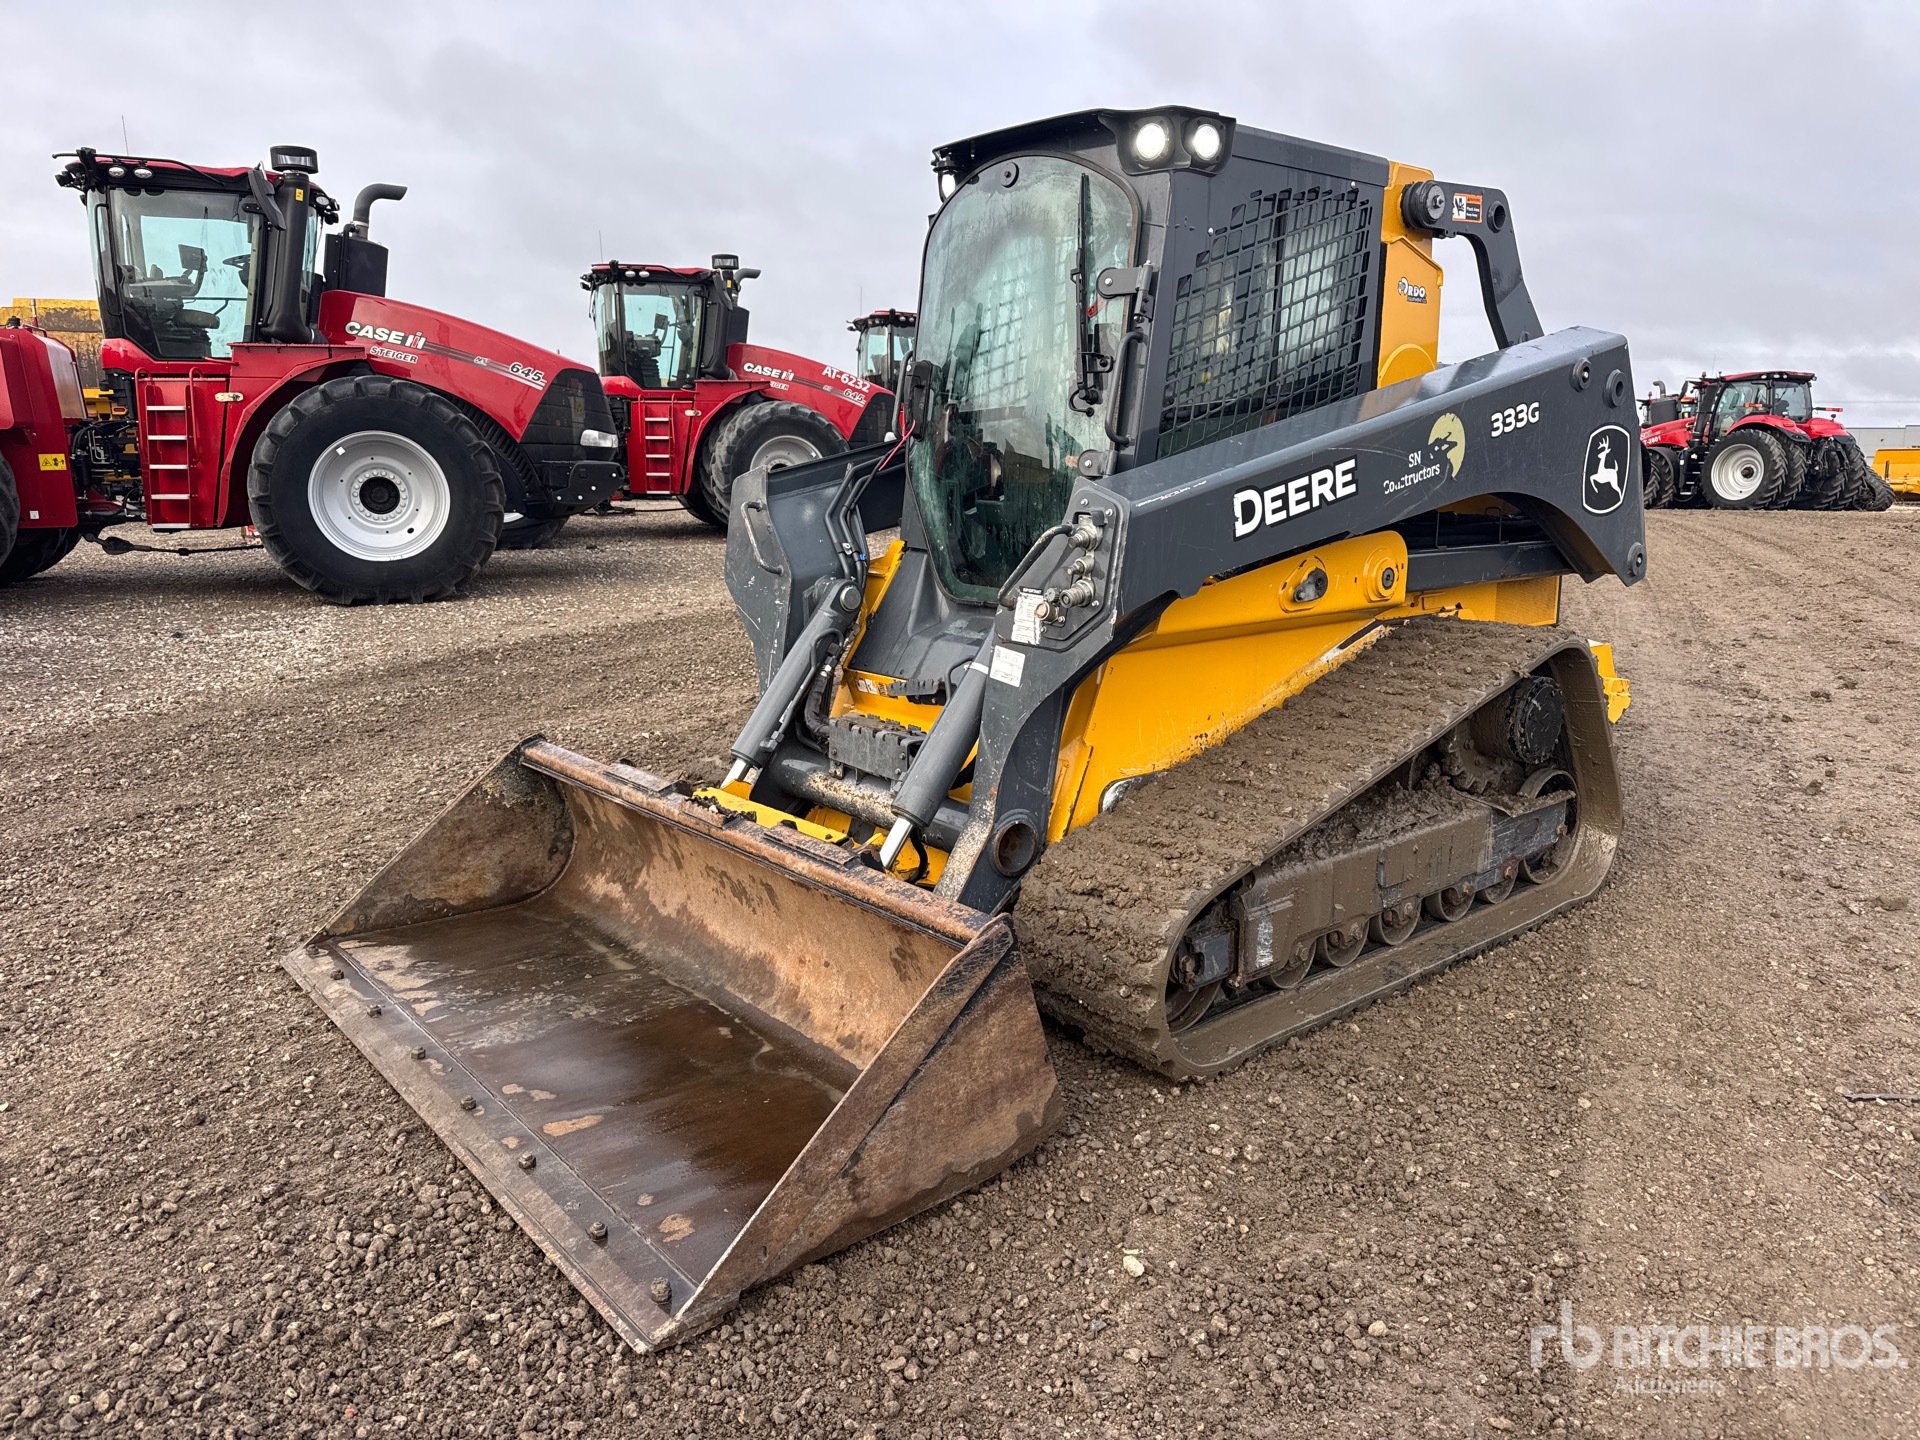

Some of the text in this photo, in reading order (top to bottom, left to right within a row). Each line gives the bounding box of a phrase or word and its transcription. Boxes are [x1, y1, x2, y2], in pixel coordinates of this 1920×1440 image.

[345, 321, 405, 344] CASE
[369, 346, 419, 364] STEIGER
[509, 362, 545, 382] 645
[743, 362, 781, 379] CASE
[821, 365, 870, 393] AT-6232
[843, 388, 866, 402] 645
[1490, 402, 1540, 437] 333G
[1408, 450, 1422, 468] SN
[1233, 458, 1356, 538] DEERE
